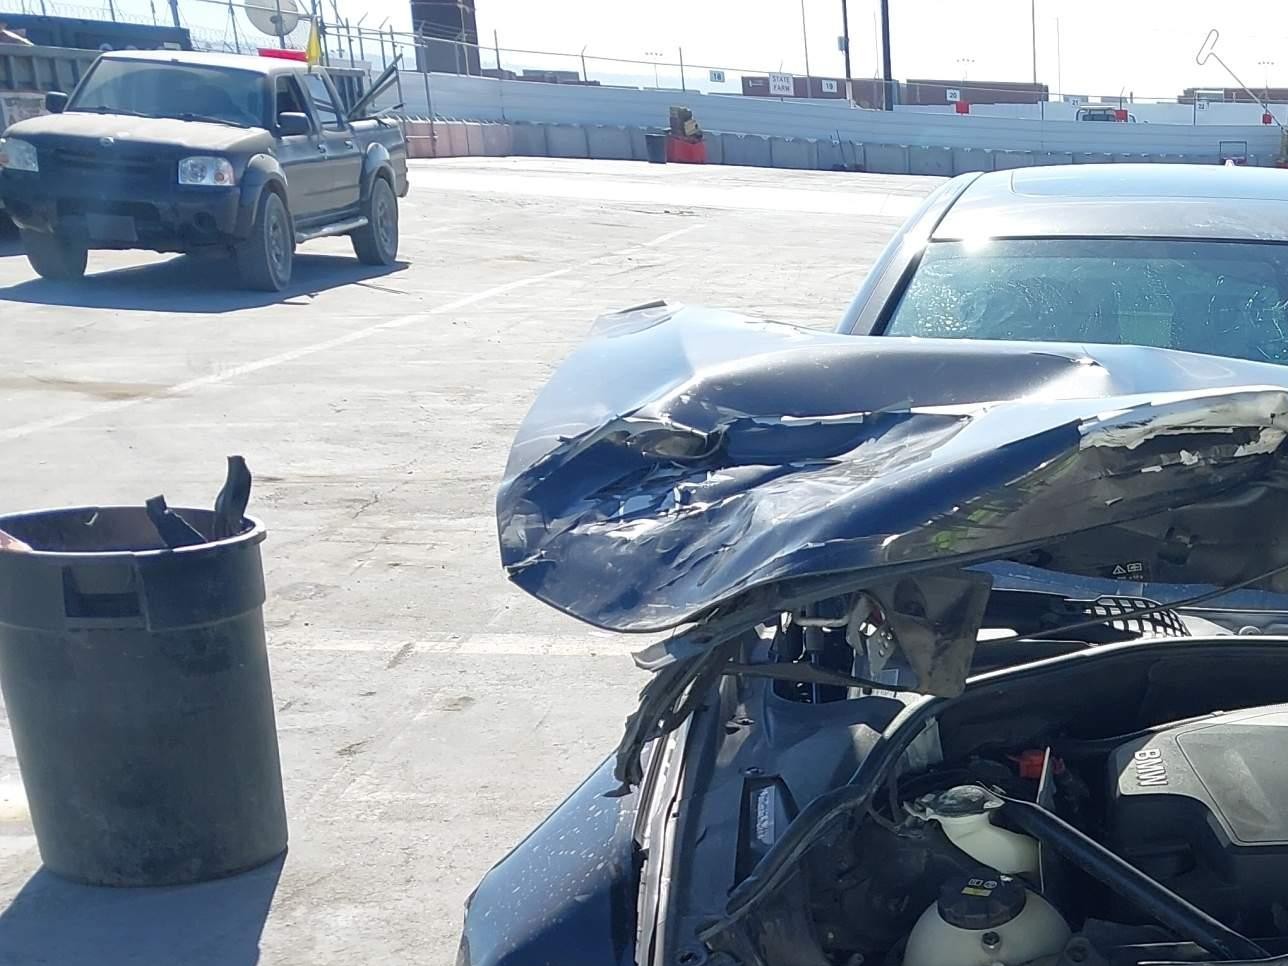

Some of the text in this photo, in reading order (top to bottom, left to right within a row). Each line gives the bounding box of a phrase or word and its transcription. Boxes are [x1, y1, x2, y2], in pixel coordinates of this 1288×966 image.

[772, 75, 790, 83] STATE
[773, 84, 790, 92] FARM
[949, 91, 957, 99] 20
[1134, 747, 1169, 787] BMW
